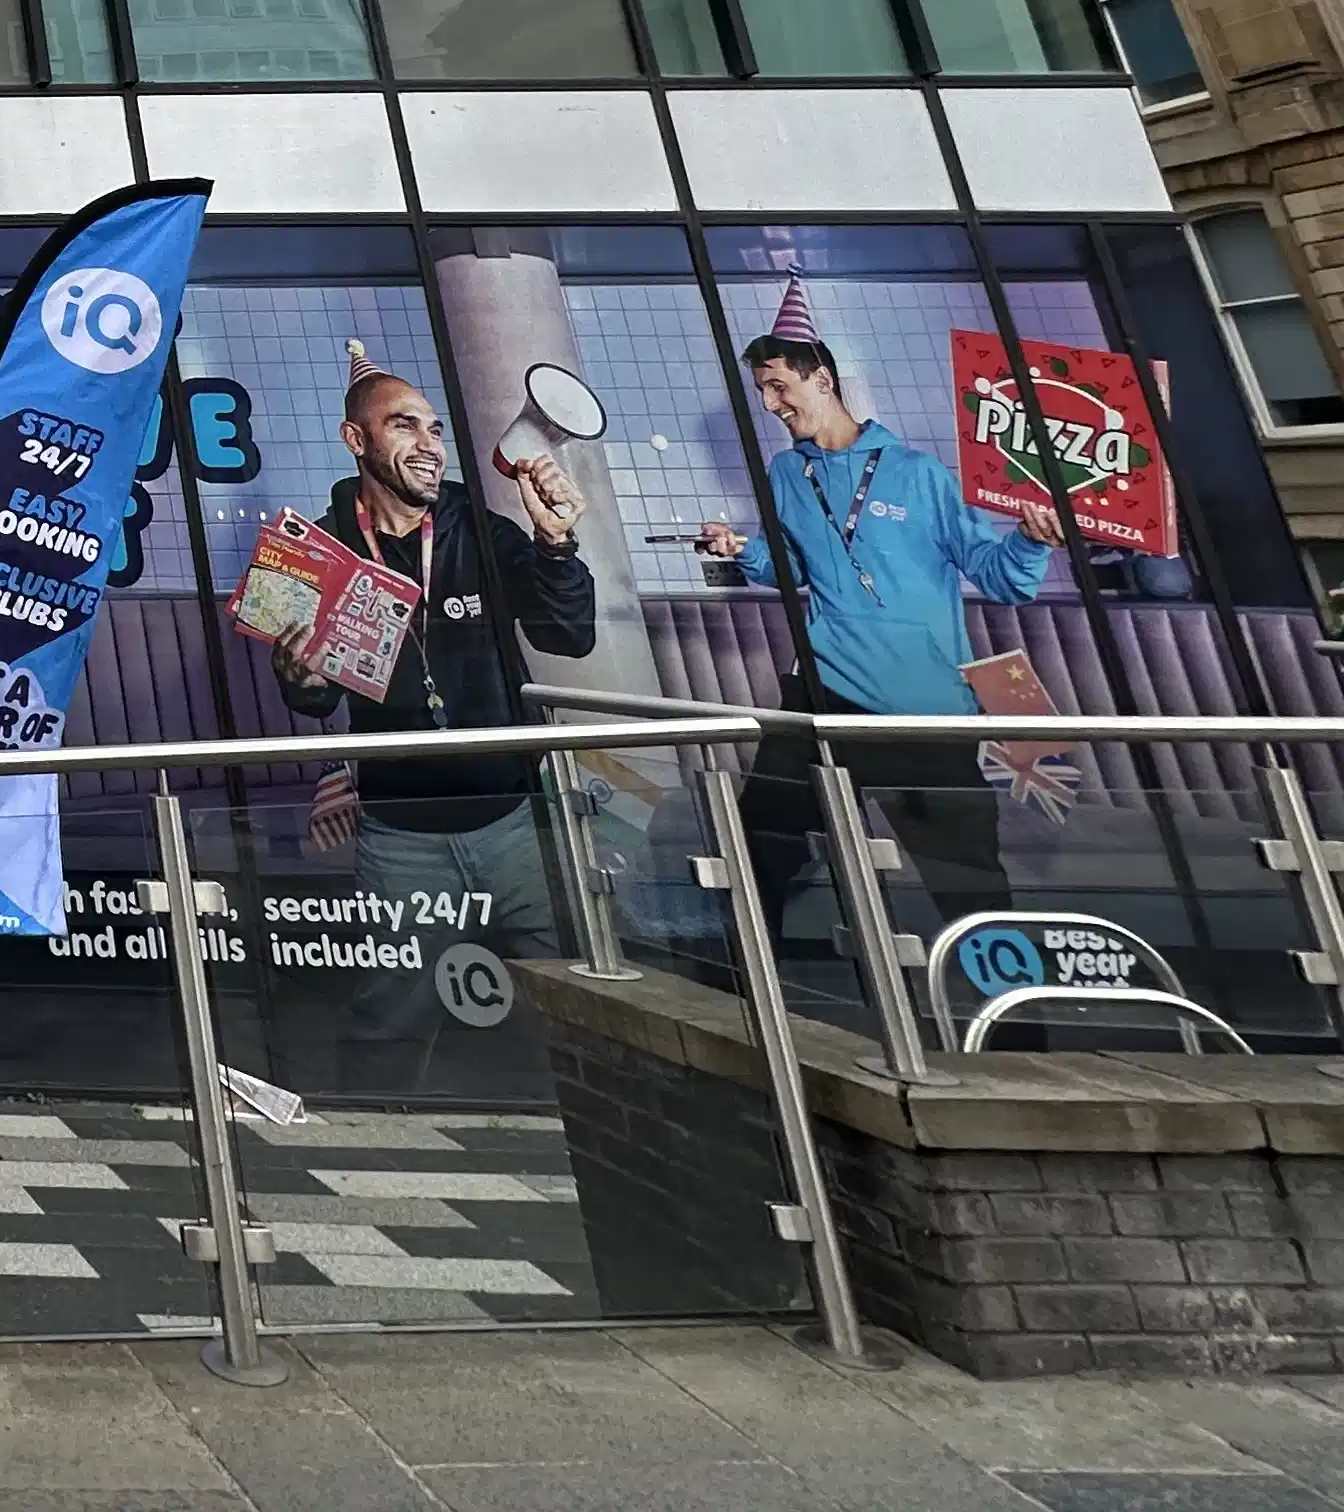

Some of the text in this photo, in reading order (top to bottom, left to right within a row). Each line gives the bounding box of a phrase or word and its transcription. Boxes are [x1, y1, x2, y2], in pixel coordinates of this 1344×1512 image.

[60, 285, 143, 355] iQ
[17, 412, 104, 455] STAFF
[19, 438, 91, 479] 24/7
[8, 487, 83, 529] EASY
[977, 488, 1020, 510] FRESH
[1097, 519, 1145, 543] PIZZA
[336, 623, 361, 642] TOUR
[337, 613, 380, 640] WALKING
[4, 674, 30, 709] A
[19, 712, 60, 743] OF
[89, 880, 144, 915] fas
[264, 891, 404, 932] security
[411, 891, 492, 930] 24/7
[48, 925, 423, 970] and all ills included
[970, 938, 1034, 984] iQ
[1056, 951, 1137, 983] year
[446, 962, 505, 1006] iQ
